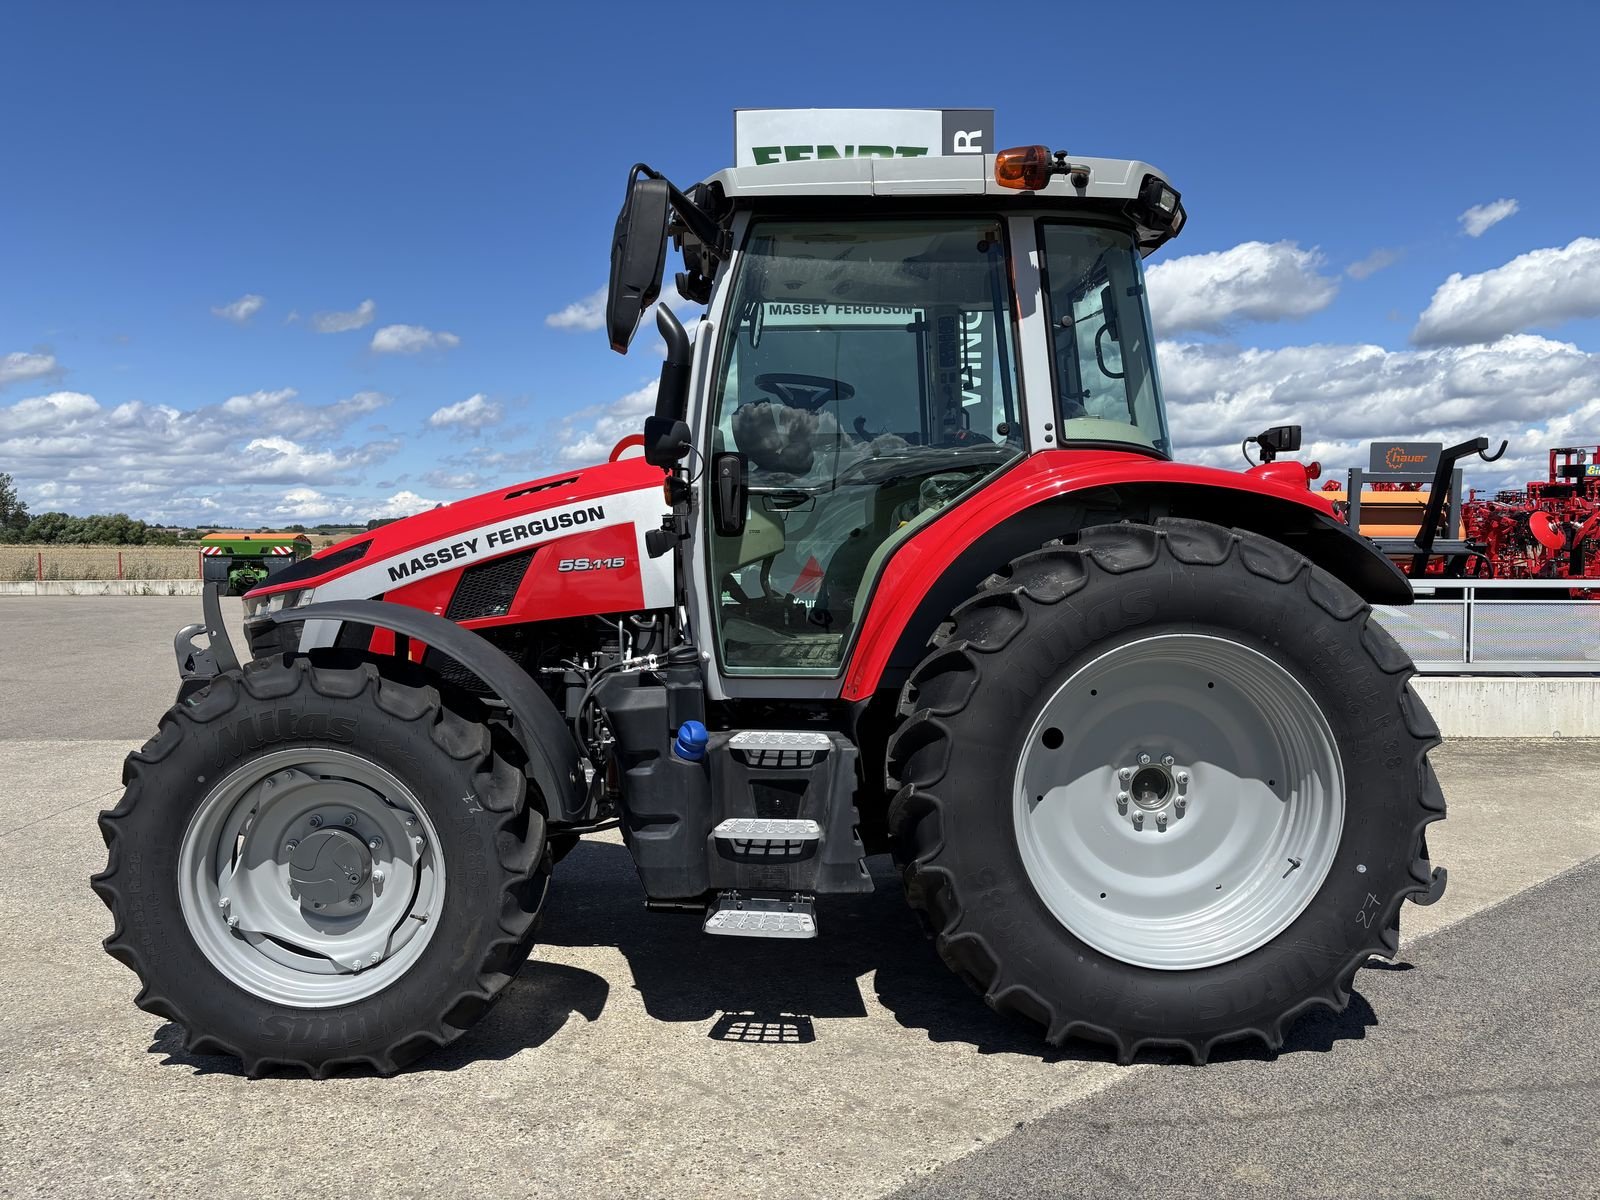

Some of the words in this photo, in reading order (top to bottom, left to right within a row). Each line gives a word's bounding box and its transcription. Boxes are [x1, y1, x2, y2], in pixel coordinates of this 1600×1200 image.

[769, 303, 829, 315] MASSEY
[835, 304, 913, 315] FERGUSON
[1391, 452, 1428, 463] hauer
[387, 538, 482, 582] MASSEY
[485, 505, 606, 548] FERGUSON
[558, 557, 625, 572] 5S.115
[215, 707, 360, 768] Mitas
